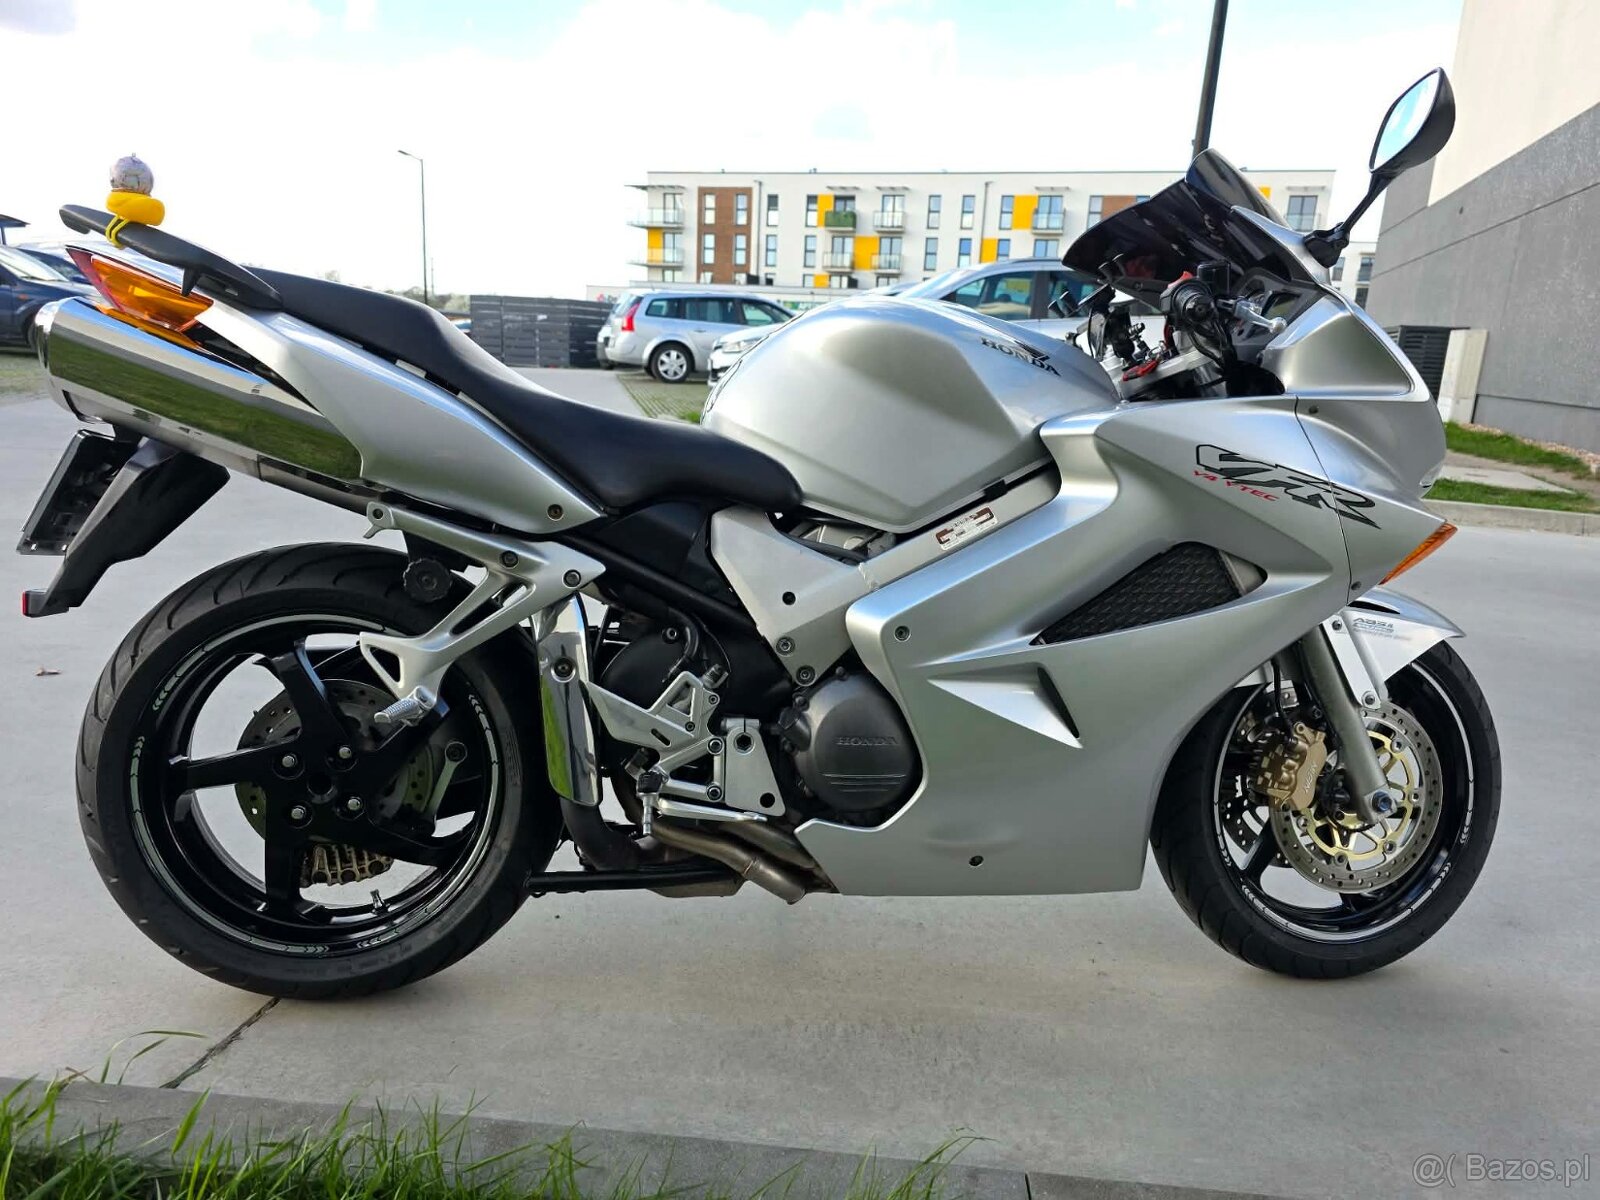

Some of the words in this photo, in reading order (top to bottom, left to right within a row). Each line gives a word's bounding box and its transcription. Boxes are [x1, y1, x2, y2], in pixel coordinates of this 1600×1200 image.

[981, 337, 1061, 377] HONDA
[1193, 469, 1219, 482] V4
[1225, 480, 1281, 502] VTEC
[1196, 444, 1382, 530] VFR
[837, 735, 899, 746] HONDA
